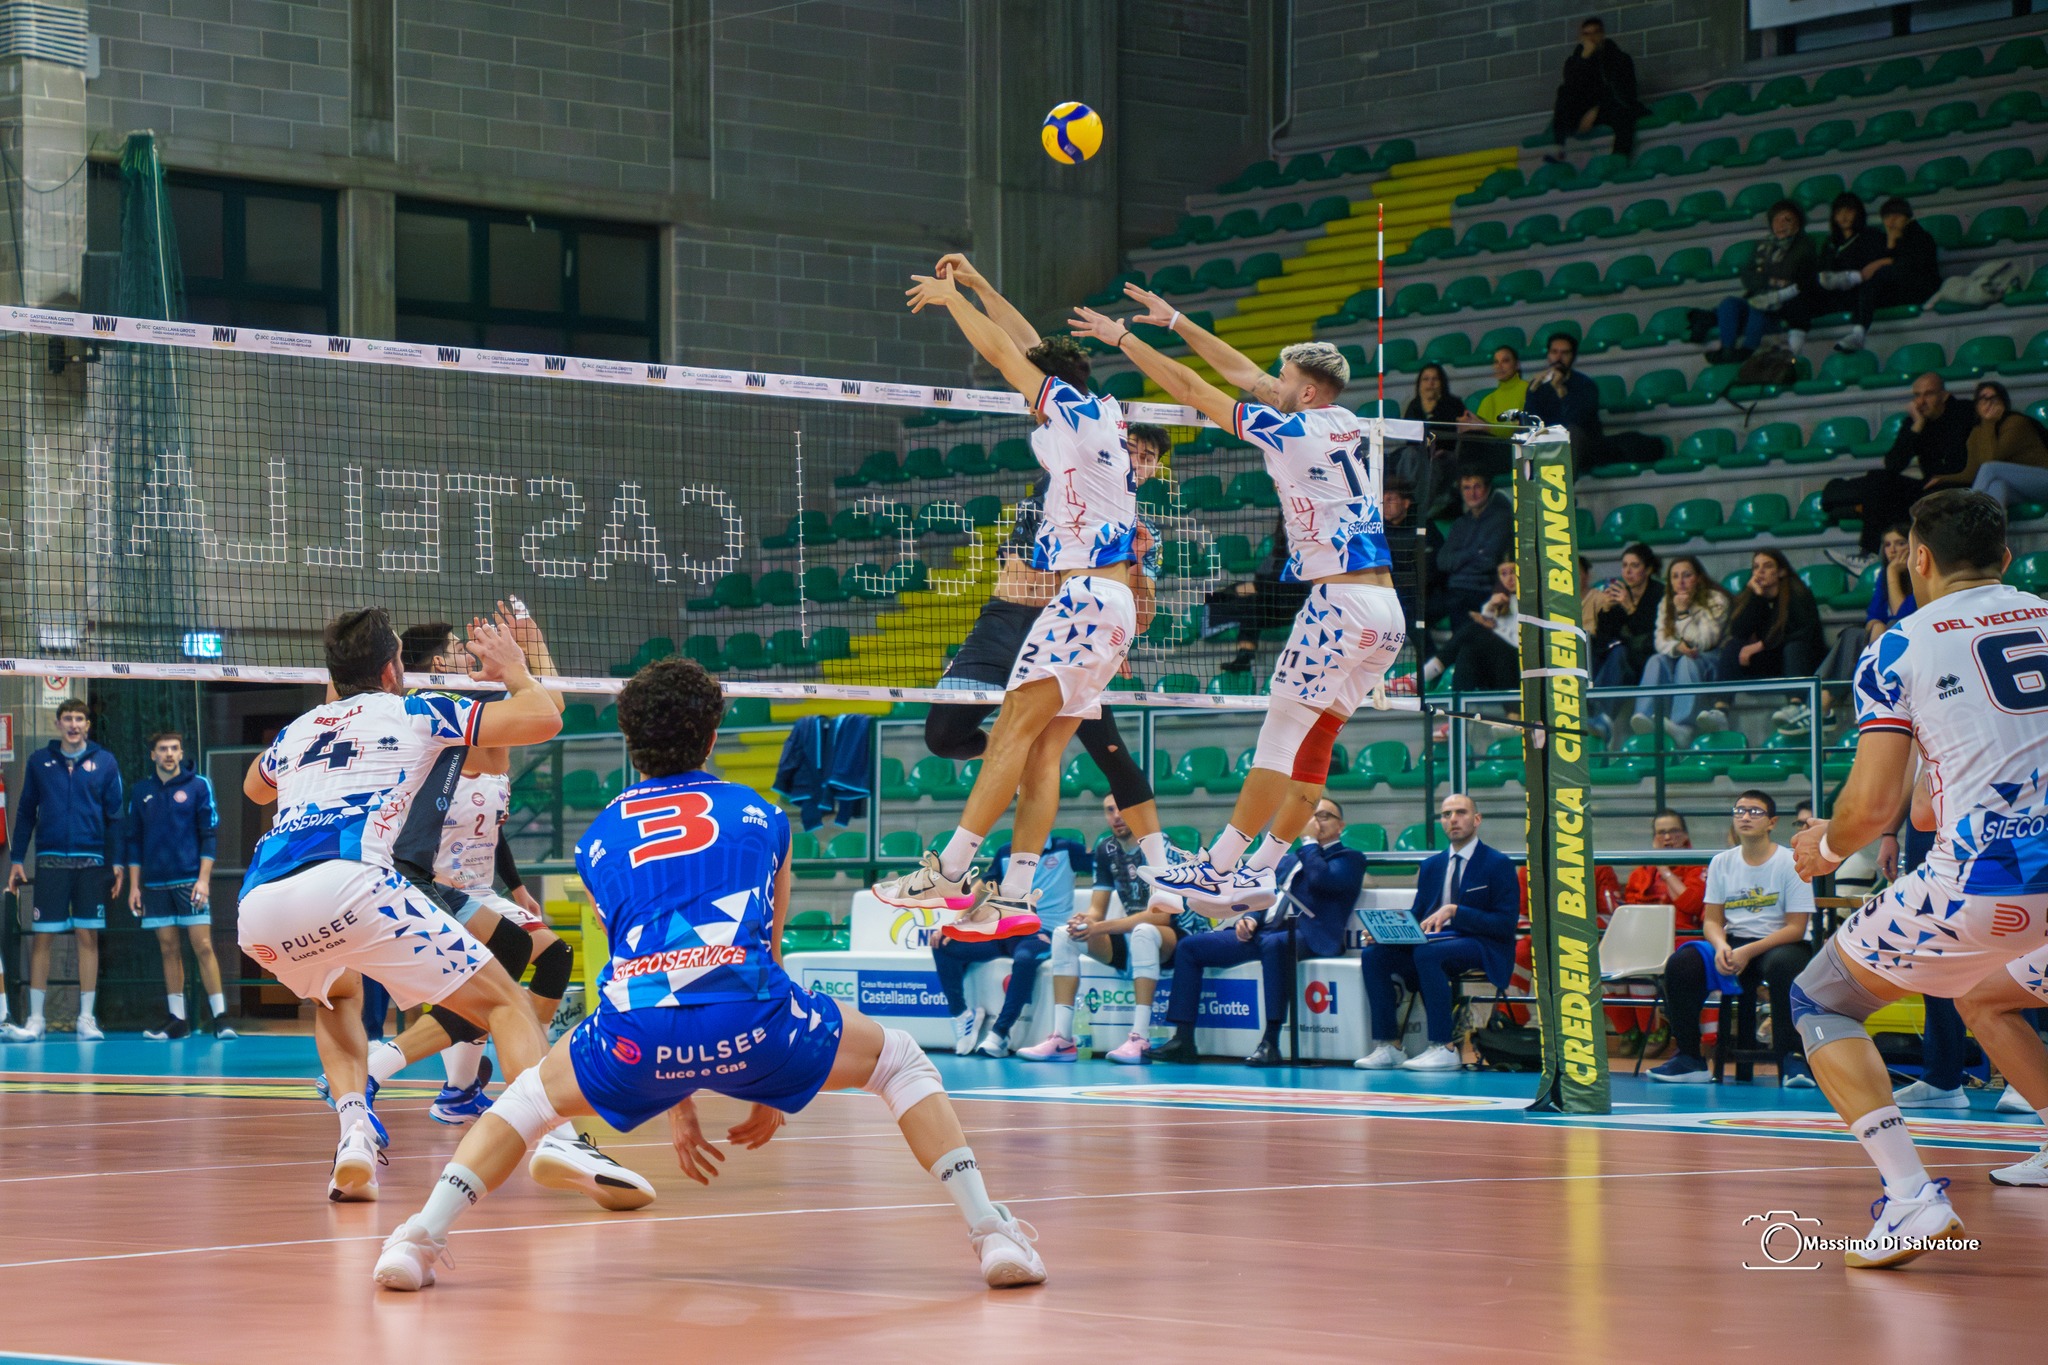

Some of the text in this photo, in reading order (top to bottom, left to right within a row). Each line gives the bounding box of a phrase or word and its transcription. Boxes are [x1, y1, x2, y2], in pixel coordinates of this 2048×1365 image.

[92, 315, 118, 332] NMV
[212, 326, 237, 343] NMV
[328, 337, 351, 353] NMV
[437, 346, 461, 363] NMV
[544, 356, 566, 371] NMV
[647, 364, 668, 379] NMV
[841, 380, 861, 395] NMV
[1540, 464, 1574, 596] BANCA
[1932, 617, 1974, 634] DEL
[1021, 642, 1040, 664] 2
[1281, 649, 1301, 669] 11
[1971, 626, 2048, 716] 6
[1550, 612, 1582, 763] CREDEM
[1938, 684, 1965, 700] errea
[296, 722, 364, 773] 4
[442, 753, 460, 794] GEOMEDICAL
[474, 813, 485, 837] 2
[621, 791, 719, 870] 3
[742, 814, 768, 829] errea
[591, 847, 607, 868] errea
[1556, 787, 1588, 920] BANCA
[281, 910, 358, 953] PULSEE
[291, 950, 318, 962] Luce
[325, 938, 347, 949] Gas
[826, 981, 854, 995] BCC
[861, 990, 917, 1005] Castellana
[1102, 990, 1135, 1004] BCC
[1209, 1001, 1250, 1016] Grotte
[1559, 935, 1598, 1086] CREDEM
[656, 1026, 767, 1064] PULSEE
[655, 1061, 748, 1080] Luce e Gas
